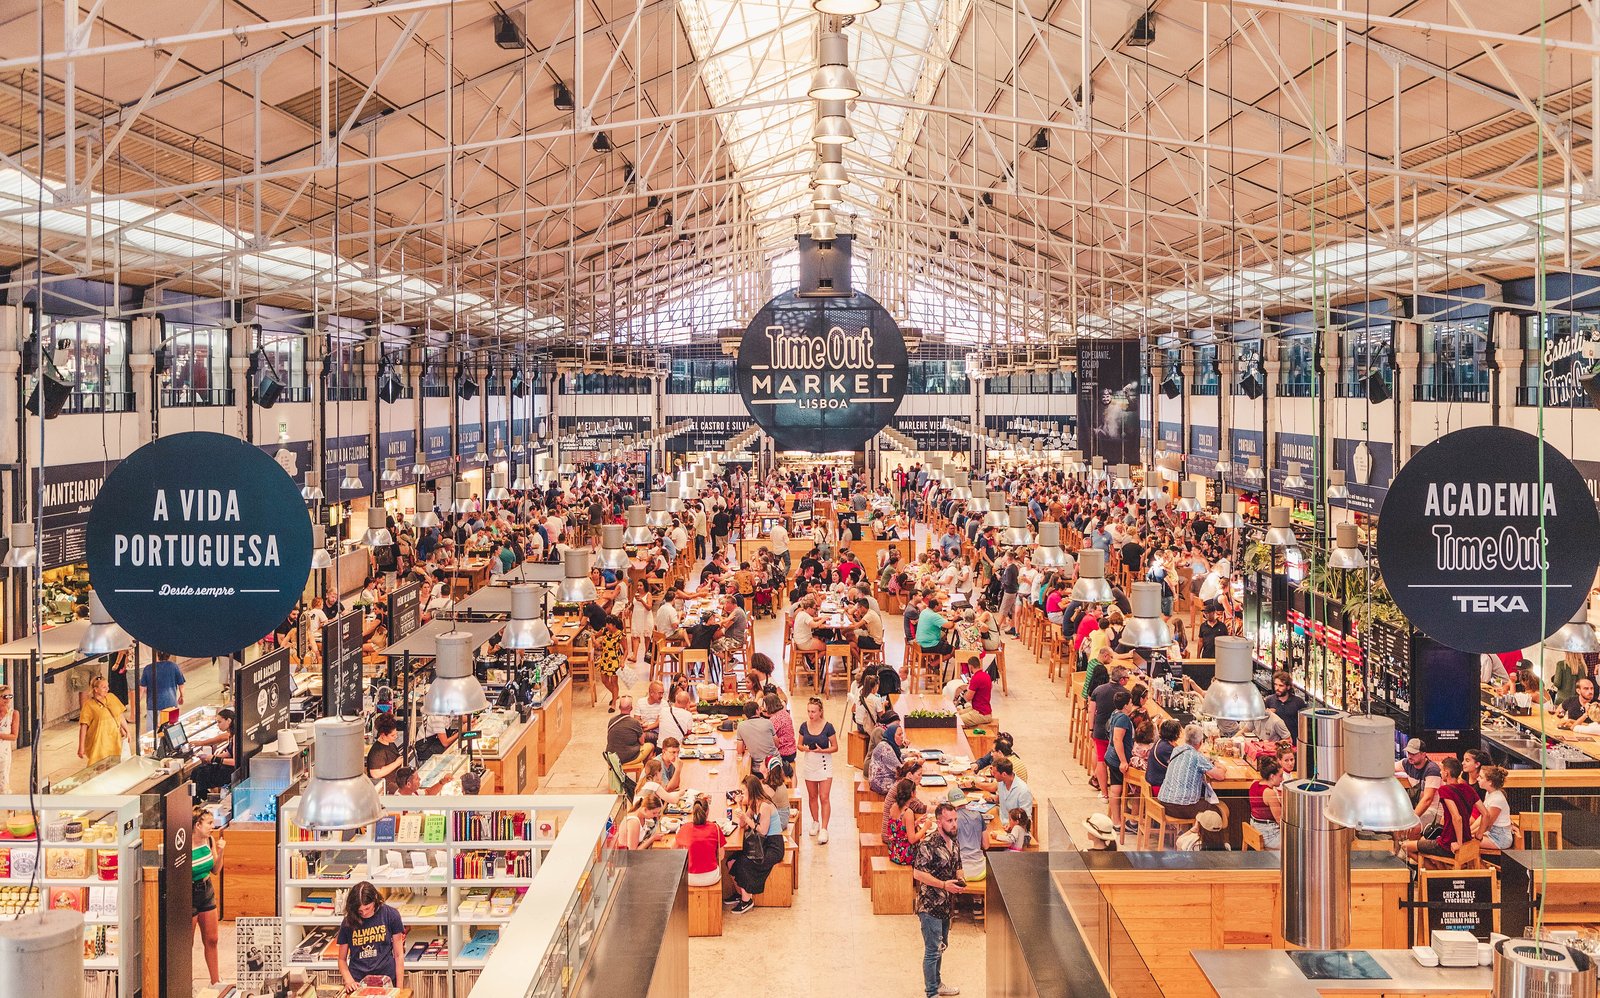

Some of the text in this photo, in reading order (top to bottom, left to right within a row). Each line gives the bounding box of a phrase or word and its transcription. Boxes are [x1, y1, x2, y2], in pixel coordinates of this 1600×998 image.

[765, 325, 874, 369] Time Out
[1544, 329, 1586, 366] Estúdi
[752, 374, 894, 394] MARKET
[798, 399, 848, 409] LISBOA
[700, 421, 725, 430] CASTRO
[726, 421, 730, 430] E
[731, 421, 750, 430] SILVA
[898, 421, 928, 429] MARLENE
[153, 489, 241, 522] A VIDA
[1424, 482, 1558, 517] ACADEMIA
[114, 534, 280, 567] PORTUGUESA
[1432, 524, 1549, 571] Time Out
[158, 584, 235, 597] Desde sempre
[1452, 595, 1529, 613] TEKA
[352, 925, 386, 938] ALWAYS
[352, 932, 386, 946] REPPIN'
